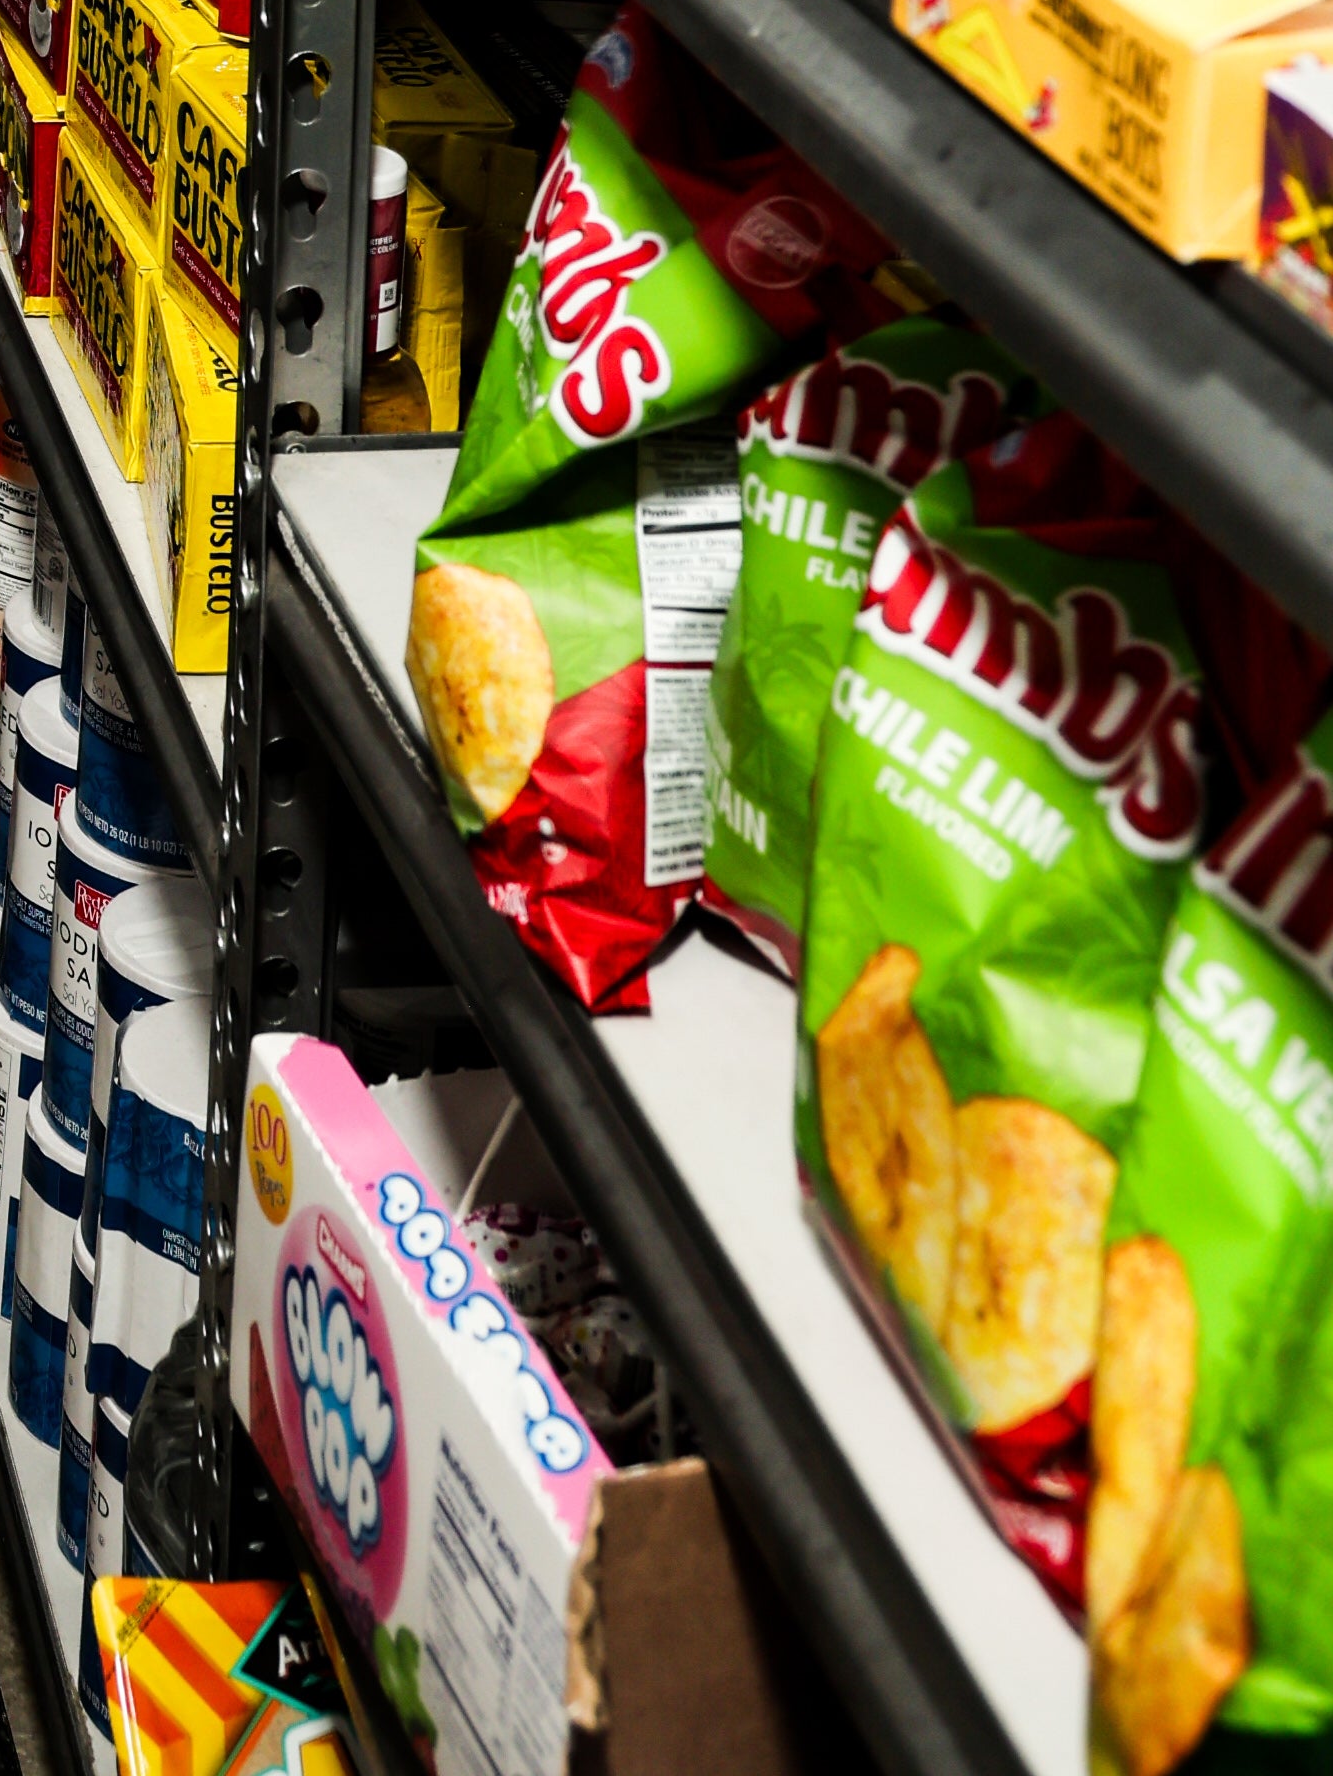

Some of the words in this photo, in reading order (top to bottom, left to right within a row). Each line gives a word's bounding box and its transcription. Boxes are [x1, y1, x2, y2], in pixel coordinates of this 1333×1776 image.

[77, 7, 161, 162] BUSTELO
[58, 232, 128, 379] BUSTELO
[207, 493, 234, 616] BUSTELO
[740, 469, 874, 558] CHILE
[830, 664, 970, 790] CHILE
[249, 1099, 286, 1167] 100
[284, 1269, 393, 1467] BLOW
[303, 1390, 378, 1548] POP
